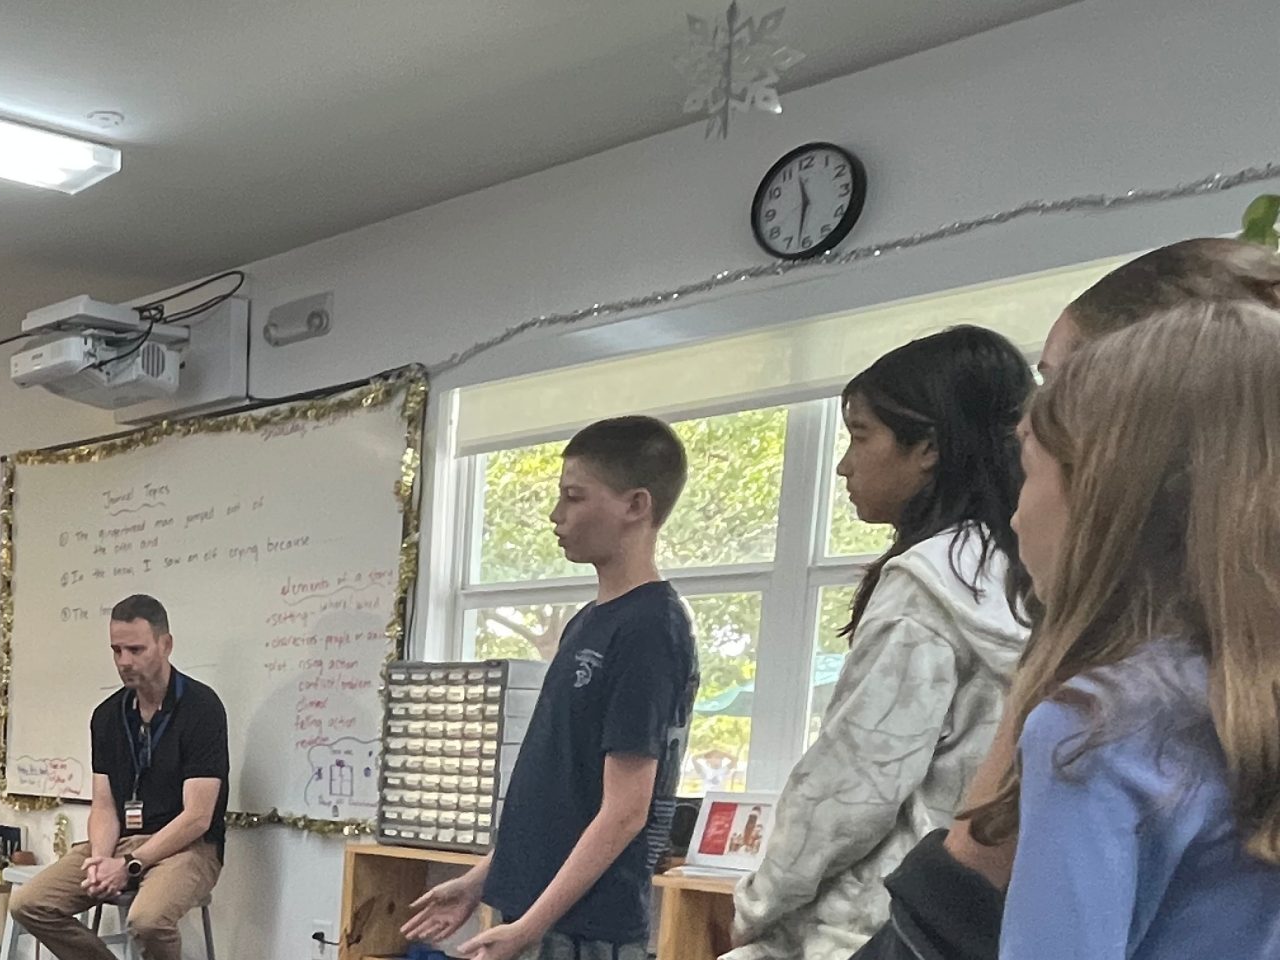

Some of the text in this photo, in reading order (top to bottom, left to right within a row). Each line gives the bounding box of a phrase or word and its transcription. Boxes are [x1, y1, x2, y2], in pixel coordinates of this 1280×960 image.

[798, 154, 815, 172] 12
[782, 167, 793, 183] 11
[832, 163, 847, 181] 2
[768, 186, 782, 201] 10
[838, 182, 851, 198] 3
[764, 208, 777, 222] 9
[833, 203, 845, 218] 4
[769, 225, 781, 240] 8
[820, 223, 832, 238] 5
[782, 235, 794, 251] 7
[801, 235, 813, 249] 6
[143, 558, 152, 573] I
[266, 535, 311, 553] because
